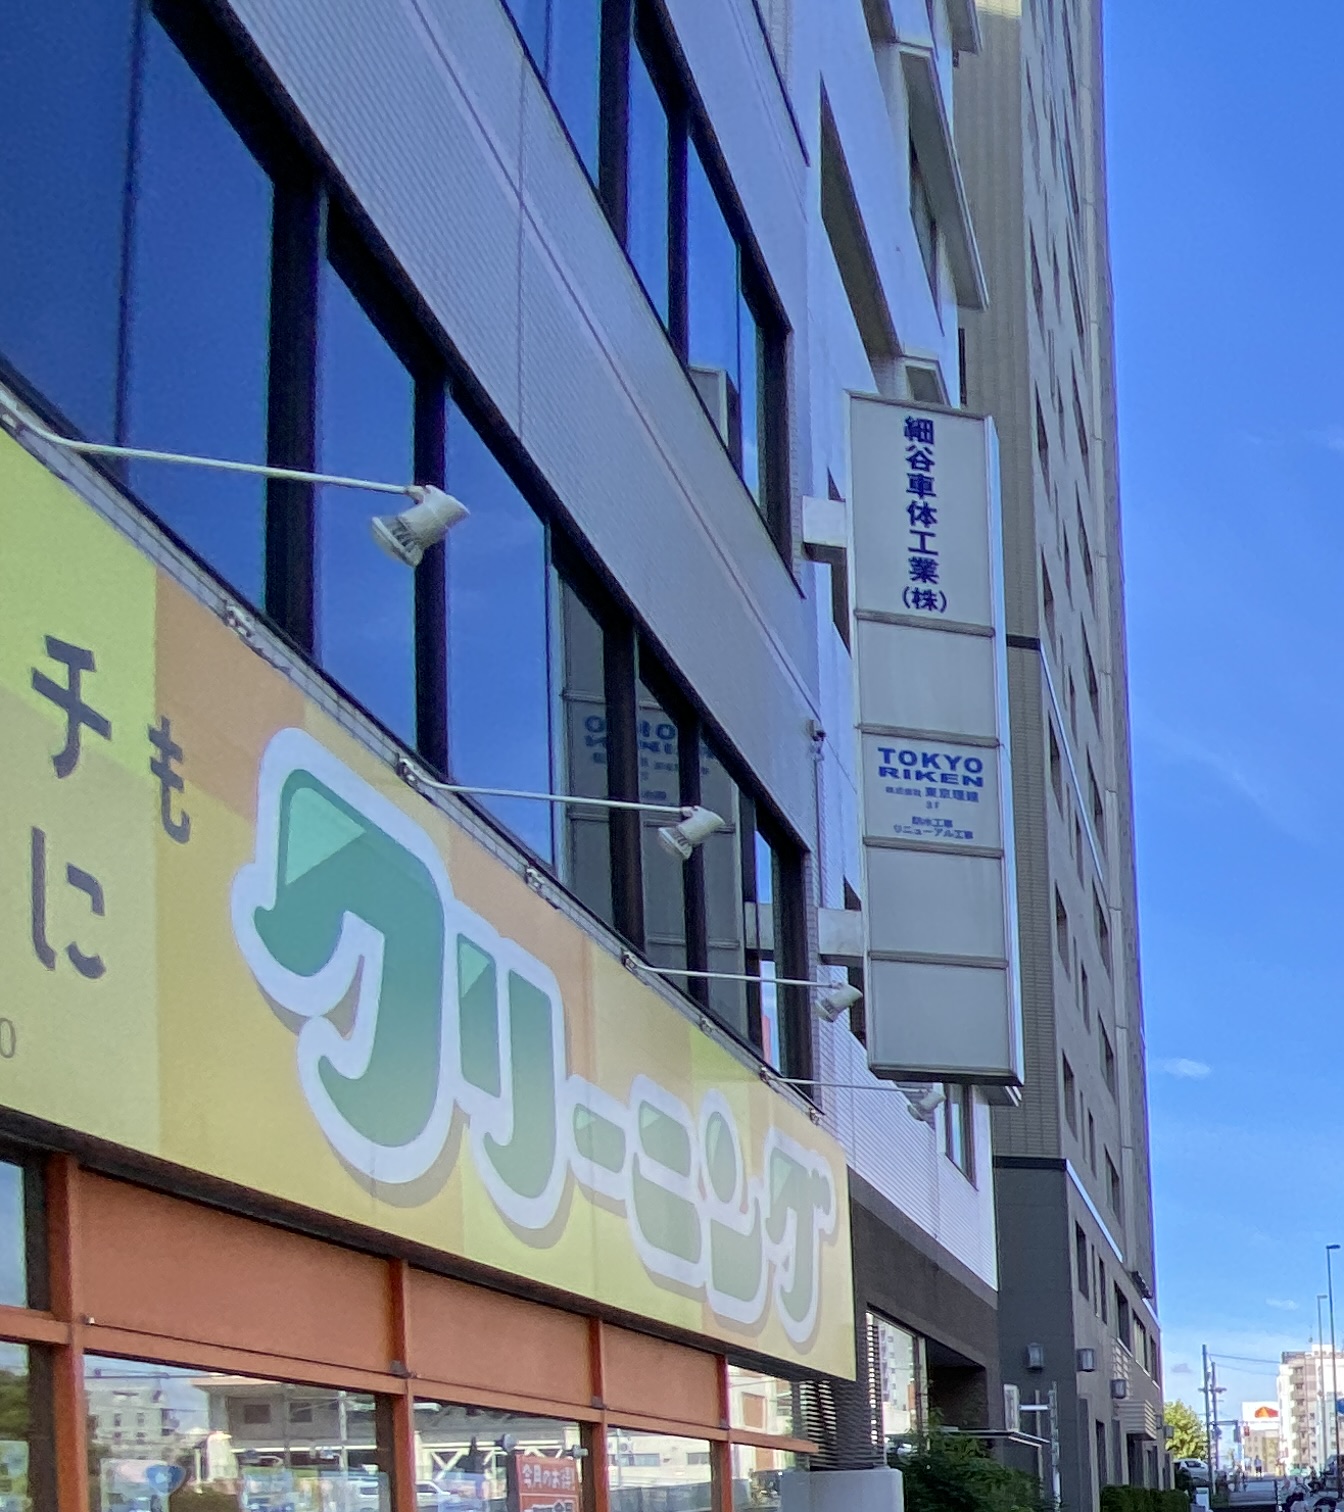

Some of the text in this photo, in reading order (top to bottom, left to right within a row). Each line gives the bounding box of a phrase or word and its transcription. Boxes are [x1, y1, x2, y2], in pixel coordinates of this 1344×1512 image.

[902, 415, 948, 614] 細谷車体工業(株)
[877, 747, 984, 774] TOKYO
[878, 766, 984, 788] RIKEN
[31, 826, 106, 980] に
[232, 728, 836, 1345] クリーニング
